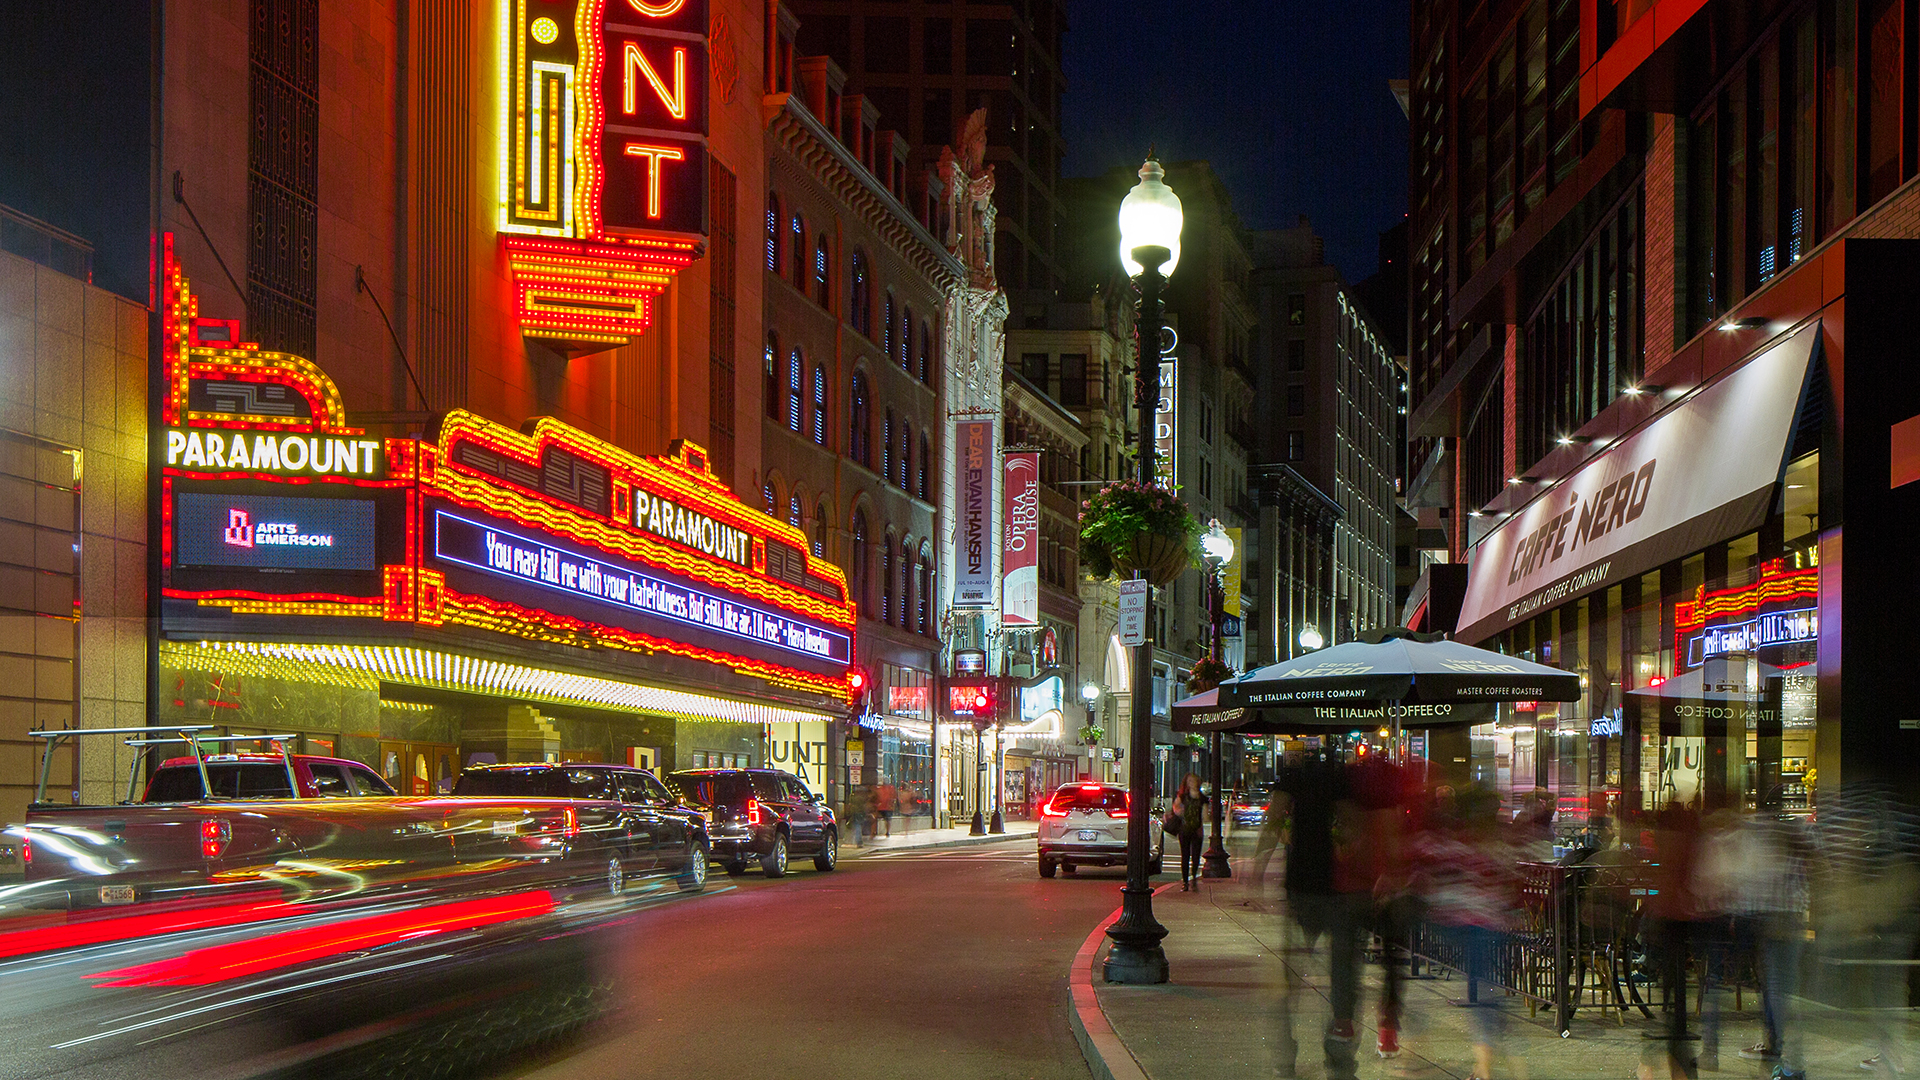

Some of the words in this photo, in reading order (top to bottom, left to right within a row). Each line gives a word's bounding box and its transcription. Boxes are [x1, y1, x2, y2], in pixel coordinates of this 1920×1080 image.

[167, 430, 380, 474] PARAMOUNT
[969, 423, 983, 468] DEAR
[969, 468, 983, 511] EVAN
[1025, 480, 1037, 530] HOUSE
[1570, 458, 1656, 552] NERO
[255, 533, 332, 546] EMERSON
[256, 522, 297, 535] ARTS
[636, 489, 748, 566] PARAMOUNT
[968, 511, 982, 575] HANSEN
[1010, 493, 1026, 552] OPERA
[486, 530, 512, 571] You
[513, 547, 539, 577] may
[540, 547, 560, 584] kill
[561, 561, 578, 589] me
[579, 561, 602, 595] with
[602, 573, 628, 602] your
[689, 592, 704, 622] But
[723, 602, 739, 631] like
[1127, 597, 1138, 606] NO
[1507, 605, 1520, 621] THE
[1518, 595, 1542, 617] ITALIAN
[1543, 580, 1569, 606] COFFEE
[1569, 561, 1611, 593] COMPANY
[1121, 606, 1145, 615] STOPPING
[1249, 694, 1263, 703] THE
[1264, 692, 1293, 702] ITALIAN
[1295, 690, 1325, 700] COFFEE
[1327, 689, 1366, 698] COMPANY
[1314, 707, 1337, 718] THE
[1387, 705, 1433, 717] COFFEE
[1457, 687, 1483, 695] MASTER
[1484, 687, 1509, 695] COFFEE
[1511, 687, 1543, 695] ROASTERS
[1191, 714, 1202, 725] THE
[1201, 712, 1221, 724] ITALIAN
[764, 740, 828, 764] UNT
